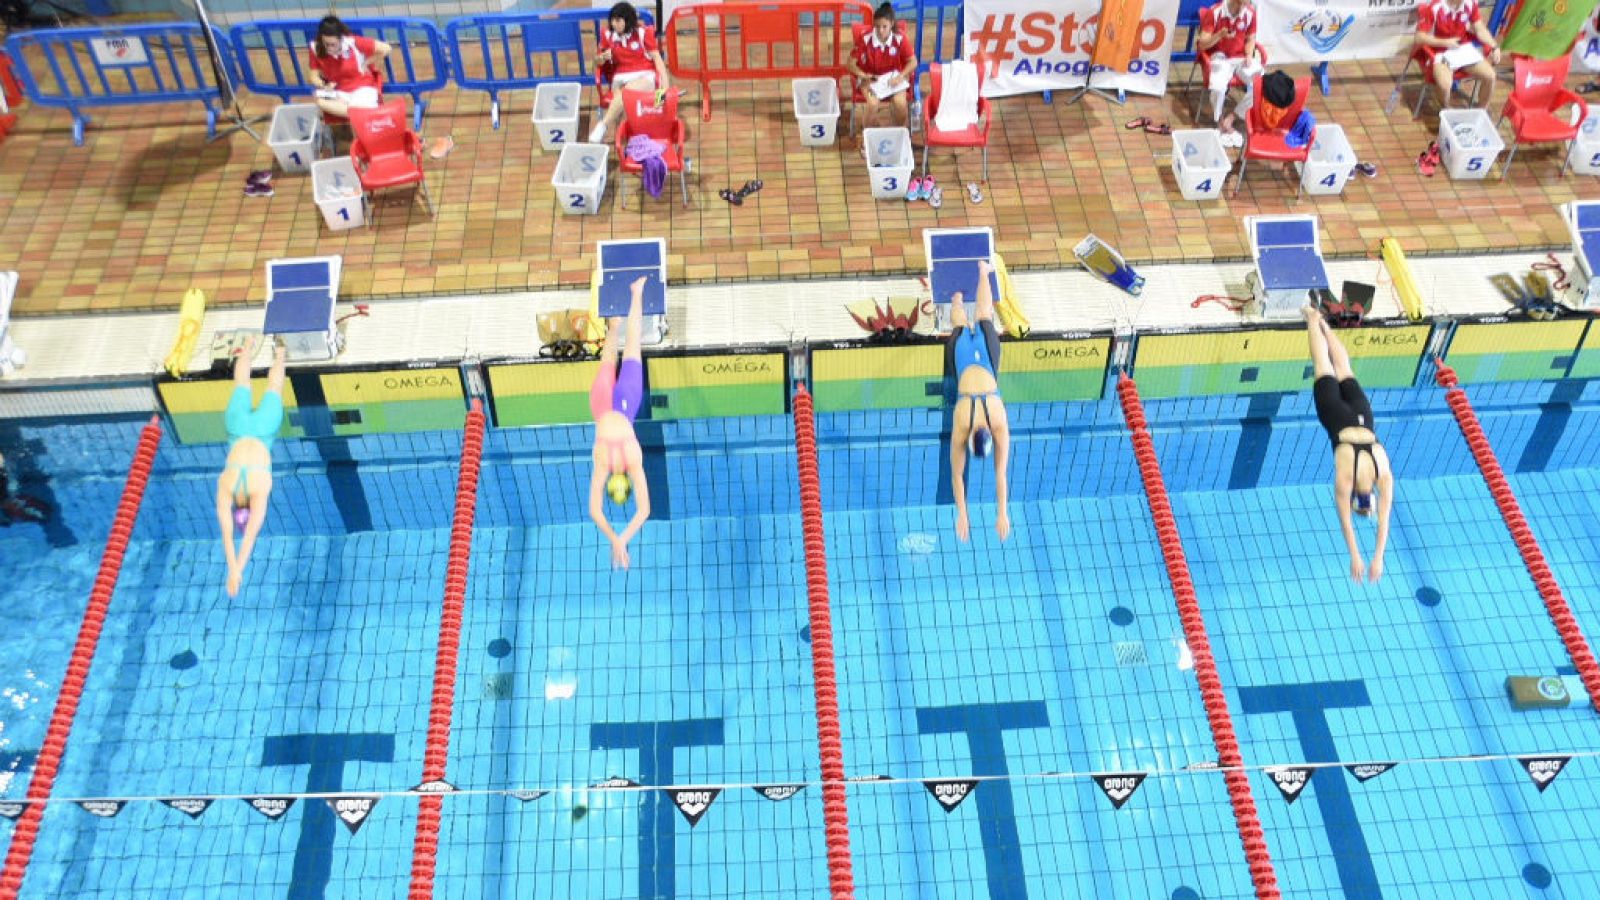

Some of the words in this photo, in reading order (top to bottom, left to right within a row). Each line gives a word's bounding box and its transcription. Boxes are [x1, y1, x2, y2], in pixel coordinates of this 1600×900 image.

[1013, 58, 1160, 76] Ahogaos
[550, 129, 565, 143] 2
[810, 124, 825, 138] 3
[289, 151, 301, 165] 1
[1466, 157, 1483, 171] 5
[882, 177, 898, 191] 3
[1195, 179, 1212, 192] 4
[1320, 173, 1336, 187] 4
[569, 193, 586, 208] 2
[336, 207, 350, 221] 1
[1034, 346, 1100, 359] OMEGA
[384, 376, 453, 389] OMEGA
[1529, 760, 1562, 772] arena
[1274, 770, 1306, 782] arena
[935, 783, 969, 796] arena
[1104, 777, 1136, 789] arena
[676, 791, 711, 804] arena
[337, 799, 370, 812] arena
